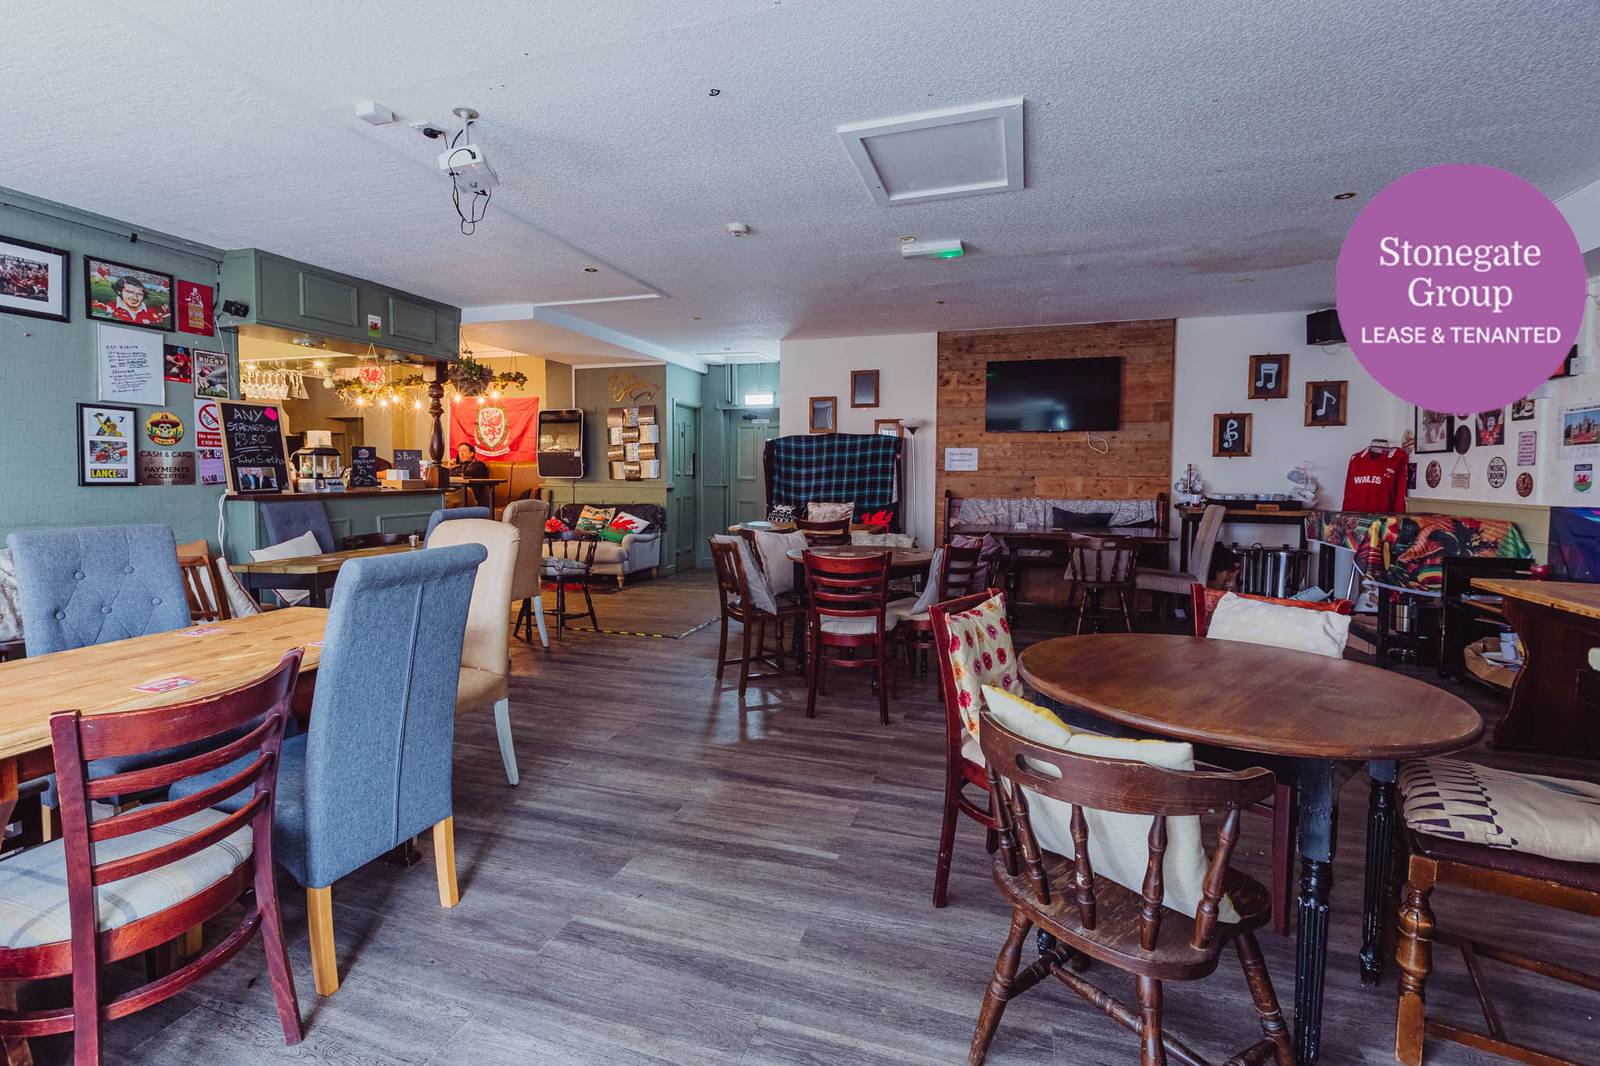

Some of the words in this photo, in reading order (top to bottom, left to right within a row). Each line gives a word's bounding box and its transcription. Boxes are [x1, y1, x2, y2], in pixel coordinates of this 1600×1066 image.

[199, 356, 224, 366] RUGBY
[233, 407, 263, 422] ANY
[234, 432, 266, 447] £3.50
[91, 469, 117, 478] LANCE
[1353, 476, 1382, 485] WALES
